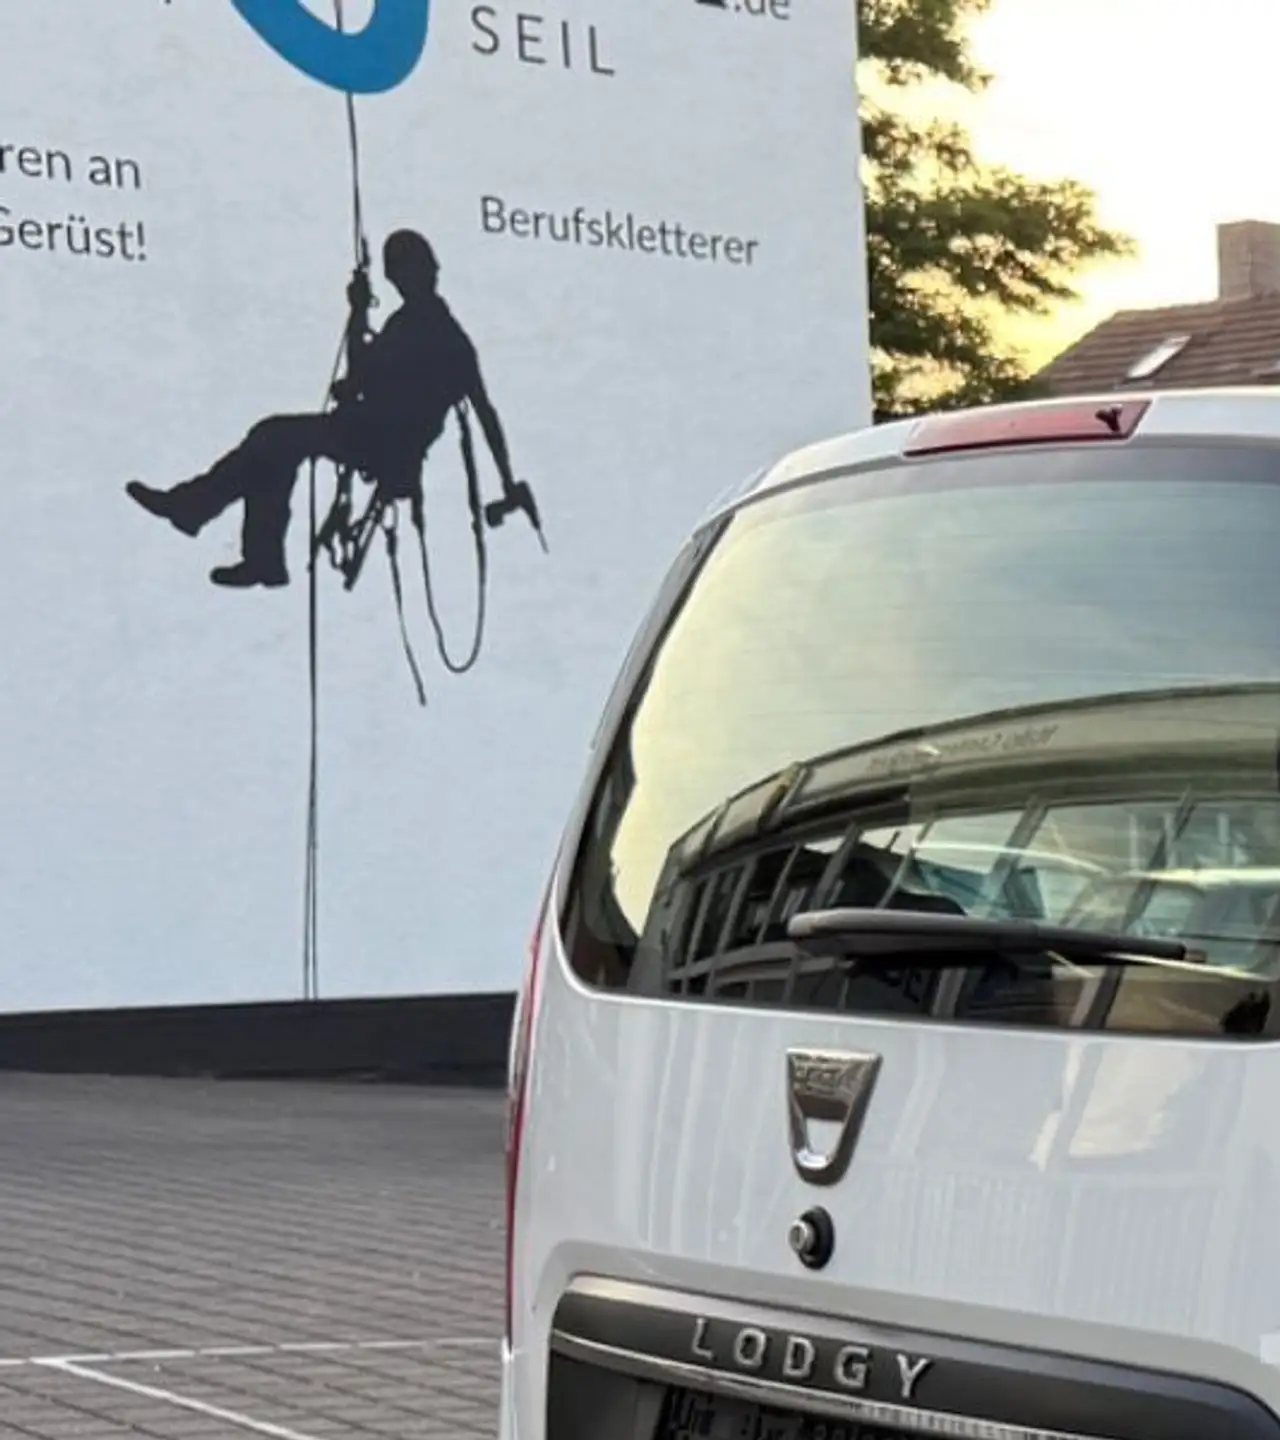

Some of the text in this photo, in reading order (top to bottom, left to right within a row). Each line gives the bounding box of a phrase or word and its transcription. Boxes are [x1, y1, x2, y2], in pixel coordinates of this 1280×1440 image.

[471, 5, 615, 76] SEIL
[88, 154, 142, 190] an
[480, 195, 760, 266] Berufskletterer
[691, 1317, 932, 1400] LODGY
